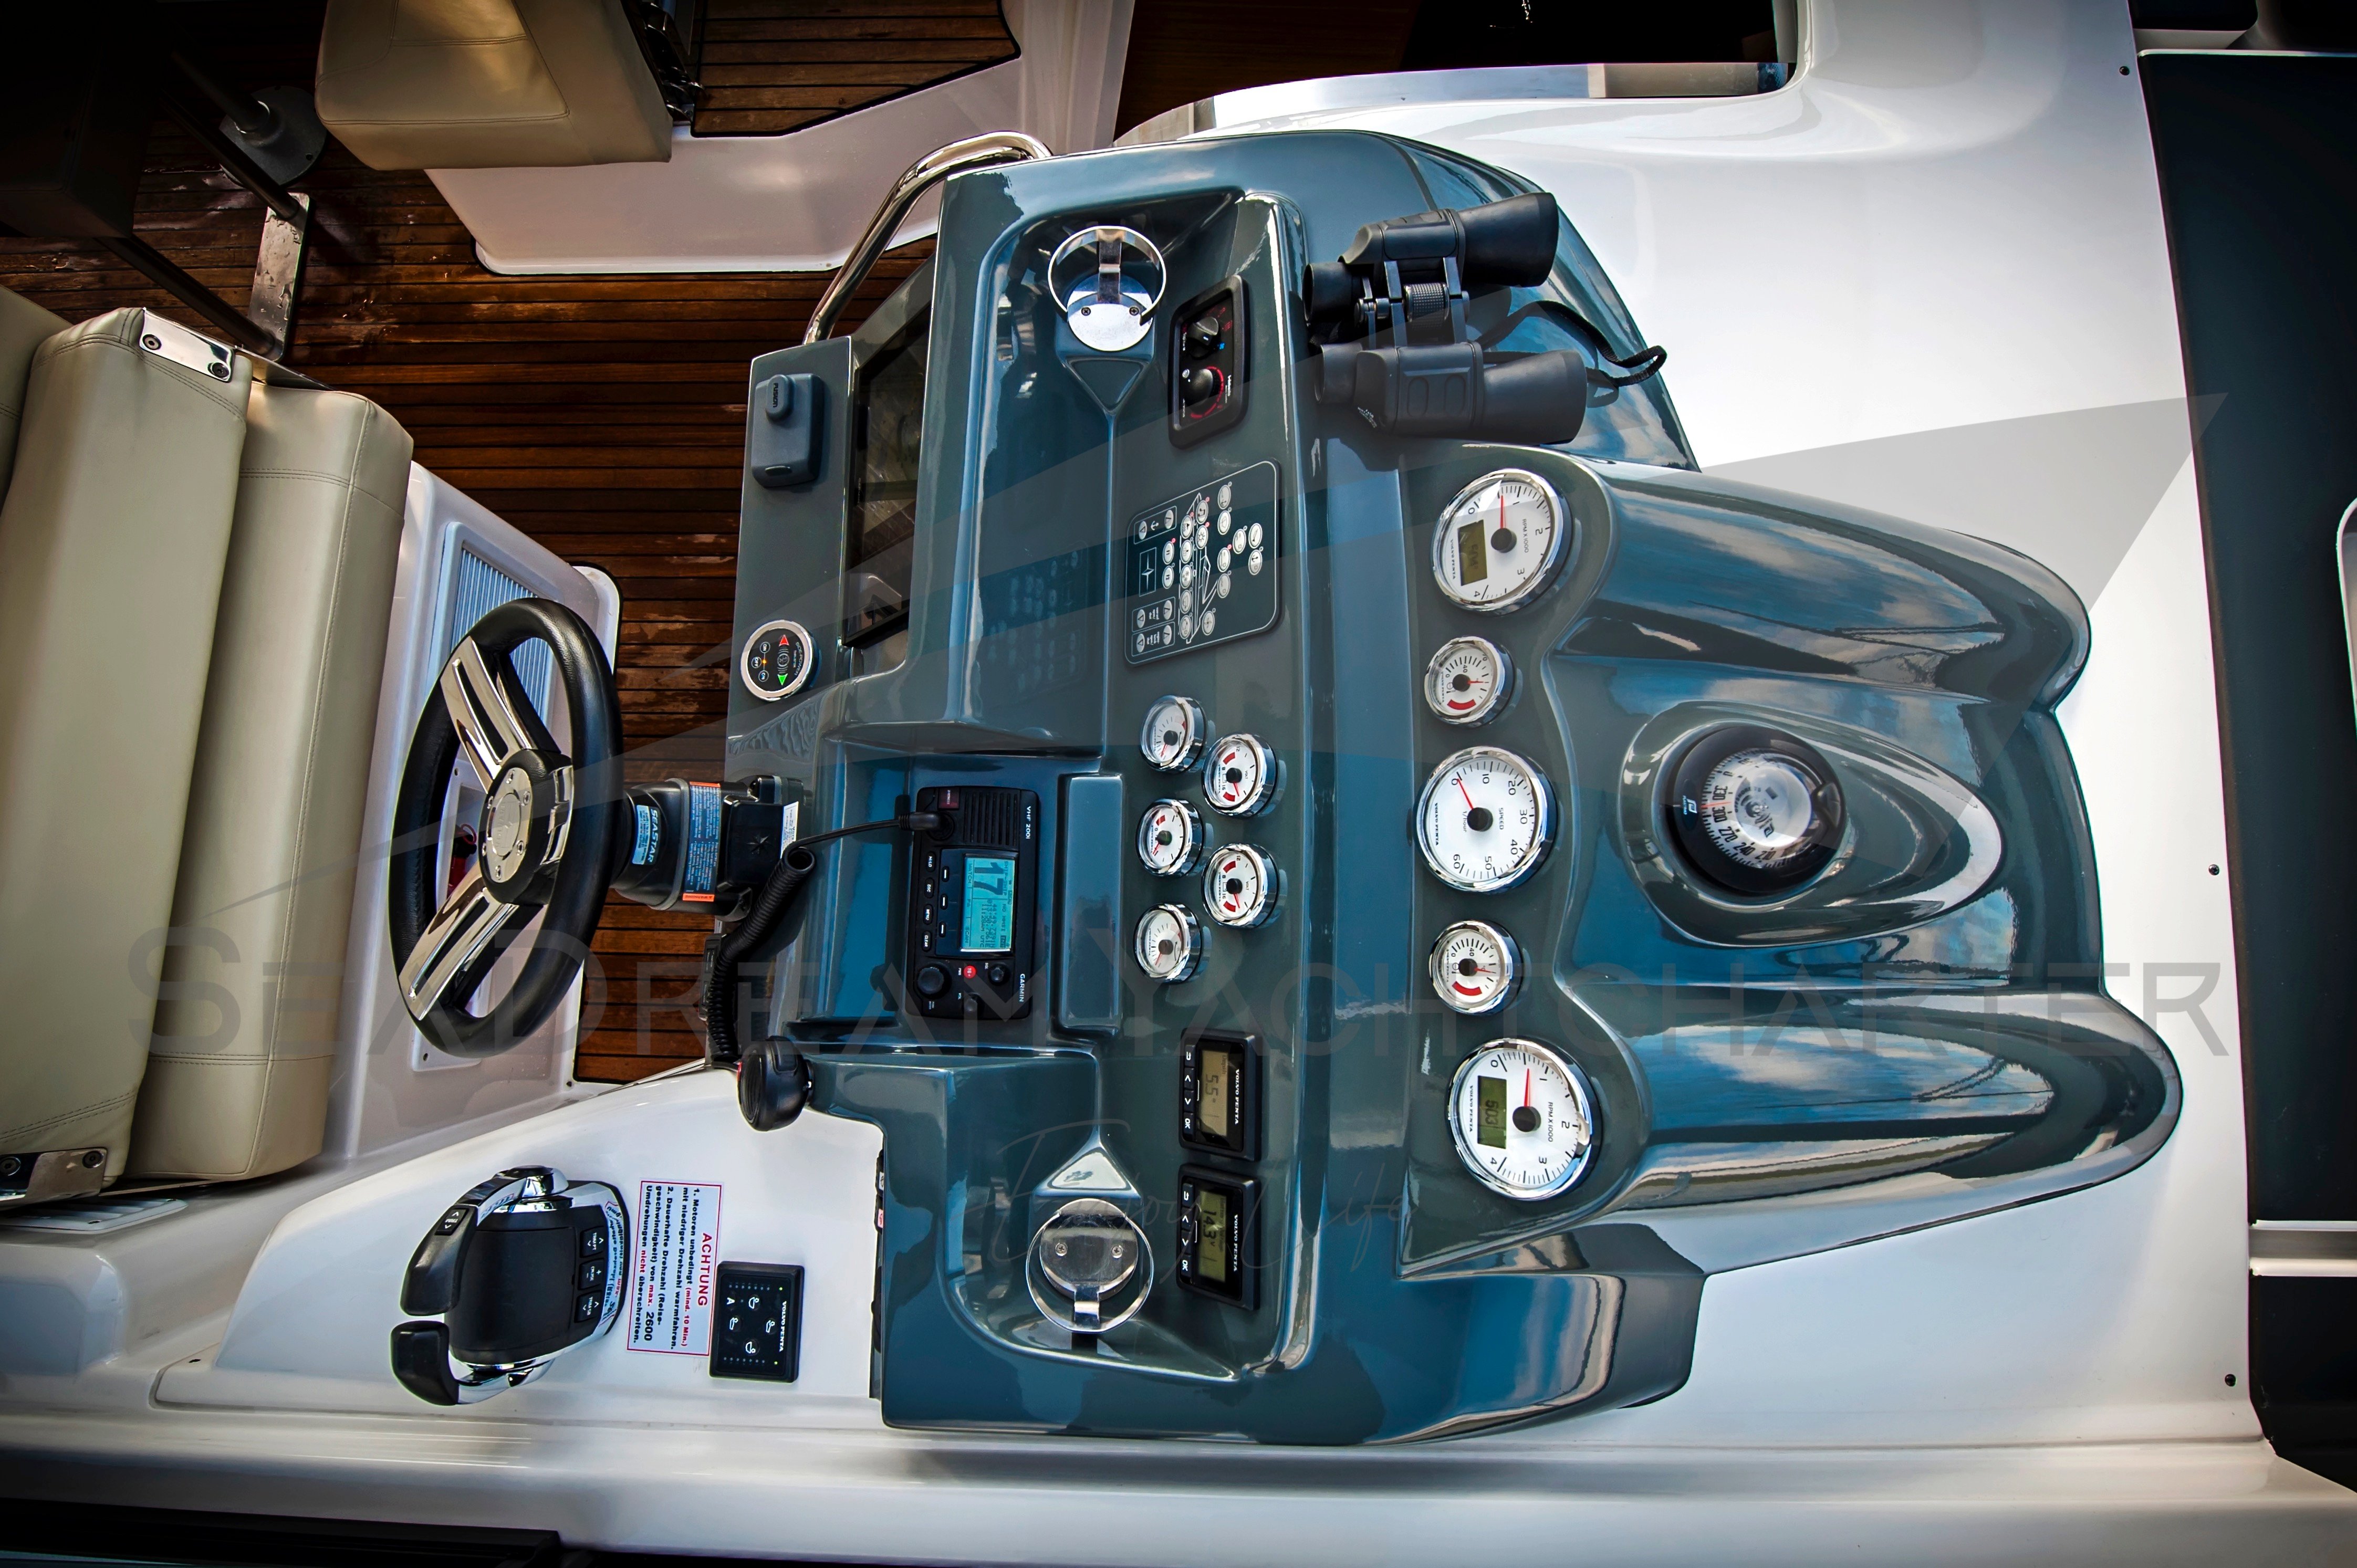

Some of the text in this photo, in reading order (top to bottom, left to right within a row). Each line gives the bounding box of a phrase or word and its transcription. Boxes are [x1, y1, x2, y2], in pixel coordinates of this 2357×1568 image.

[1482, 773, 1490, 784] 10
[1508, 780, 1516, 796] 20
[1712, 786, 1728, 800] 330
[1519, 809, 1528, 824] 30
[1714, 807, 1727, 822] 300
[1718, 827, 1738, 842] 270
[1510, 839, 1519, 855] 40
[1734, 842, 1755, 856] 240
[1453, 854, 1461, 869] 60
[1484, 856, 1492, 871] 50
[973, 862, 1004, 895] 17
[1002, 904, 1006, 912] NO
[1469, 948, 1474, 956] 40
[1185, 1118, 1191, 1129] OK
[1539, 1156, 1547, 1165] 3
[641, 1185, 652, 1247] Umdrehungen
[649, 1186, 662, 1262] geschwindigkeit)
[690, 1199, 699, 1236] Motoren
[679, 1205, 688, 1246] niedriger
[1203, 1210, 1216, 1239] 14.3
[657, 1186, 673, 1325] 2. Dauerhafte Drehzahl (Reise-
[686, 1239, 696, 1284] unbedingt
[675, 1248, 685, 1288] Drehzahl
[698, 1233, 712, 1306] ACHTUNG
[1182, 1260, 1188, 1271] OK
[633, 1276, 645, 1343] überschreiten.
[644, 1312, 654, 1341] 2600
[671, 1291, 681, 1350] warmfahren.
[683, 1315, 690, 1324] 10
